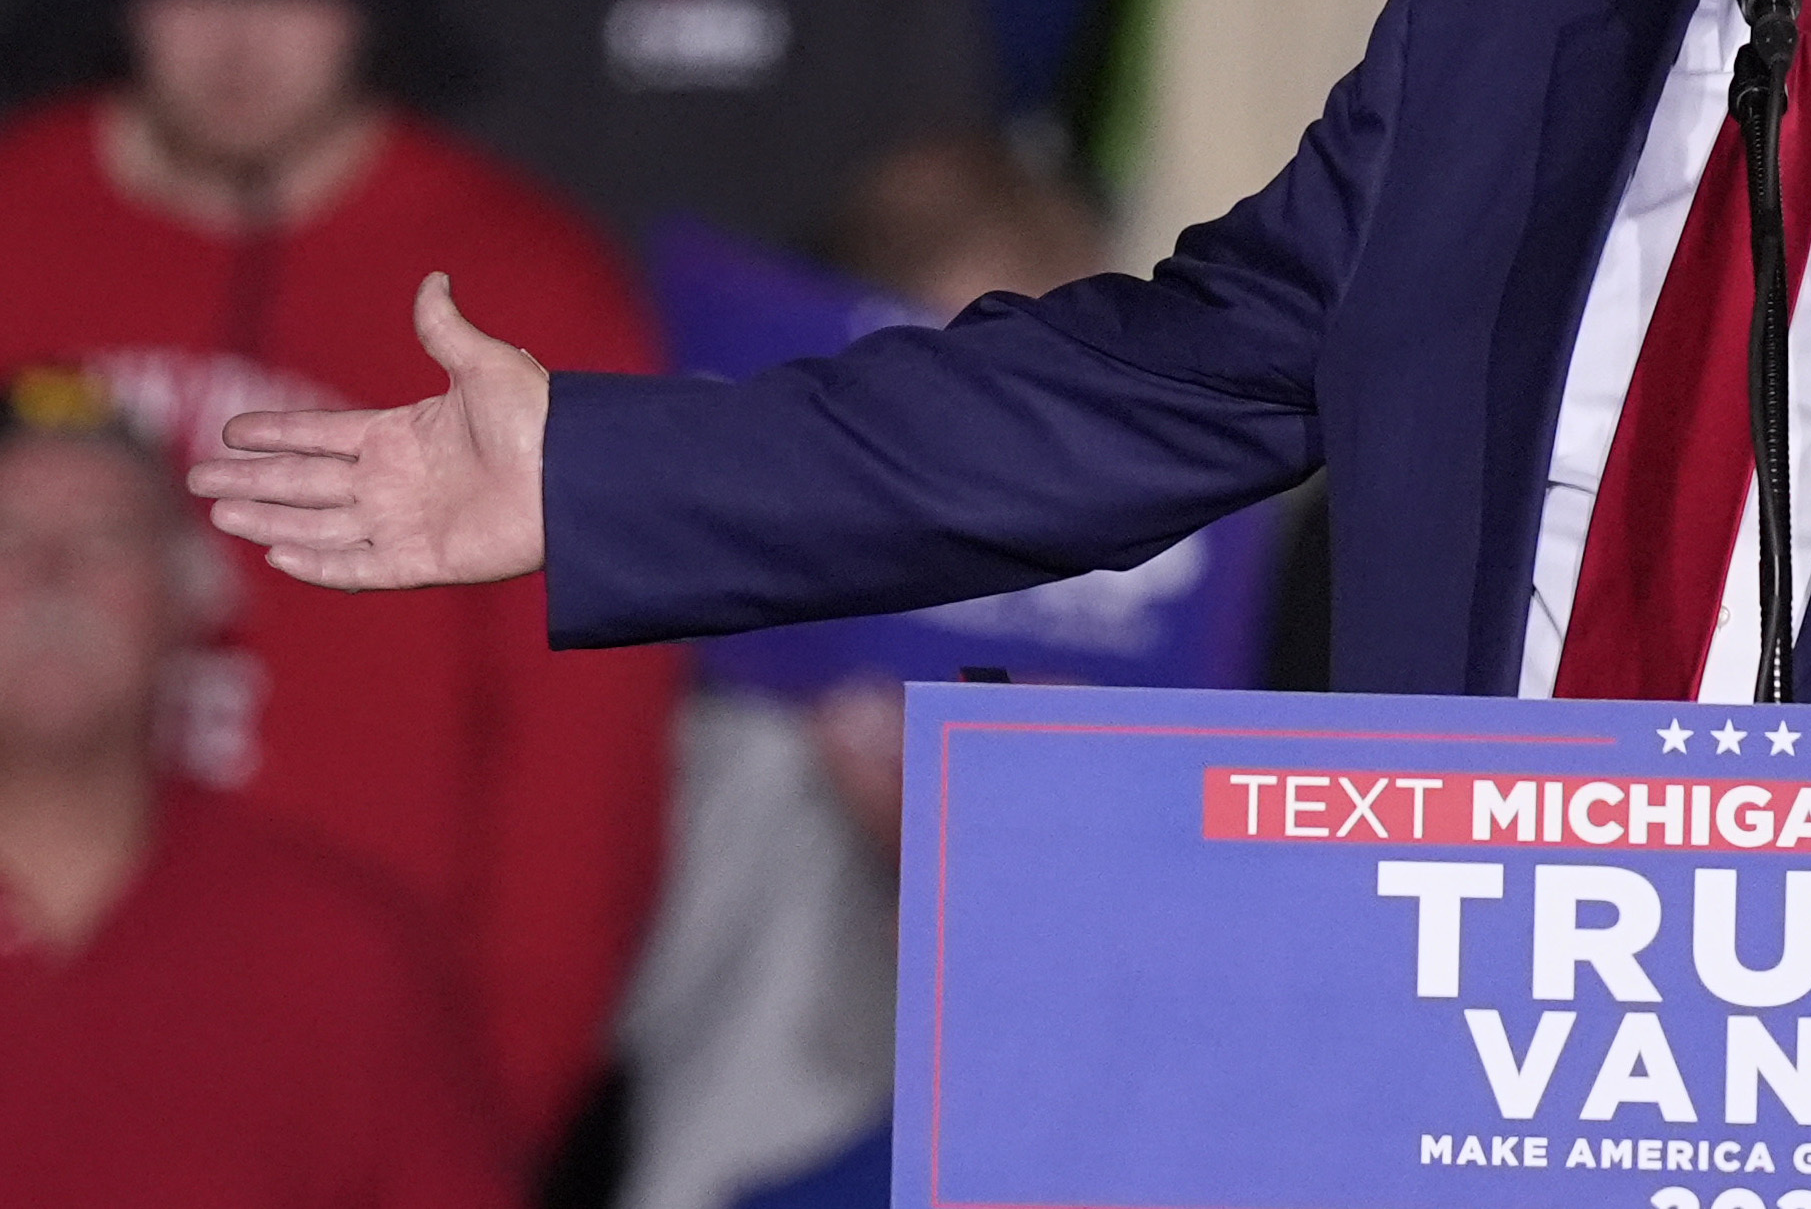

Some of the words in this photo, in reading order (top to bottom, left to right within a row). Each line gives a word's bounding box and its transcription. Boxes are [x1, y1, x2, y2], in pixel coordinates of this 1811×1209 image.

[1229, 774, 1444, 839] TEXT
[1420, 1134, 1549, 1167] MAKE
[1565, 1137, 1776, 1173] AMERICA
